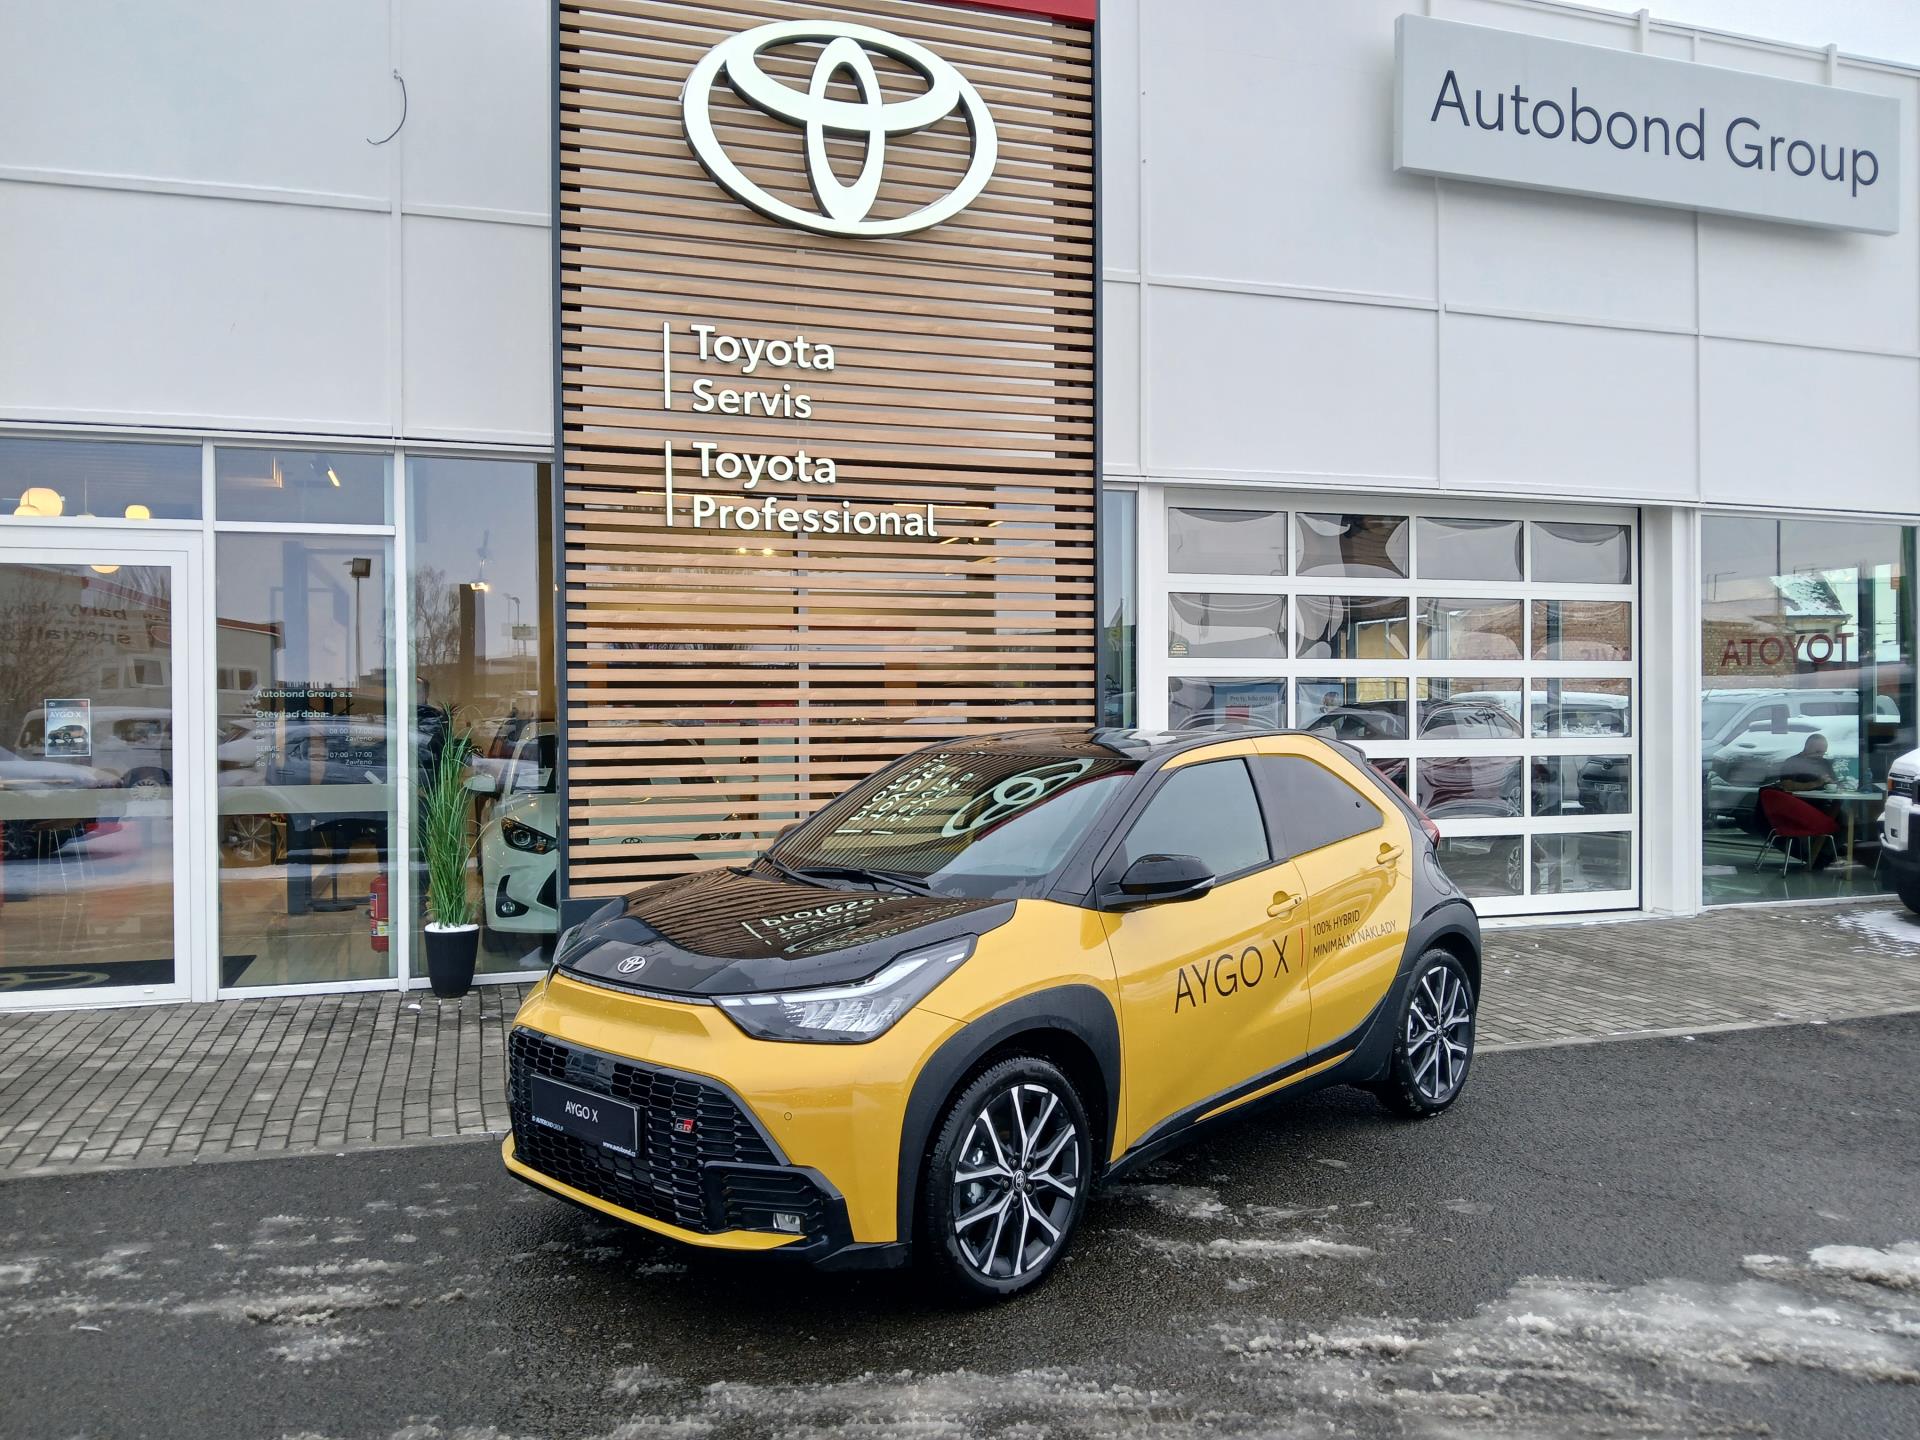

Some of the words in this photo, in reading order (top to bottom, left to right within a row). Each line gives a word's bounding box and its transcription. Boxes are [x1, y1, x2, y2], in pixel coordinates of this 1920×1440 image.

[1430, 69, 1706, 161] Autobond
[1725, 116, 1880, 198] Group
[690, 323, 835, 374] Toyota
[692, 378, 813, 419] Servis
[692, 441, 837, 490] Toyota
[693, 494, 938, 537] Professional
[255, 690, 305, 698] Autobond
[307, 690, 337, 699] Group
[1313, 920, 1333, 936] 100%
[1333, 910, 1360, 930] HYBRID
[1175, 945, 1264, 1014] AYGO
[1272, 935, 1290, 978] X
[565, 1100, 591, 1120] AYGO
[591, 1109, 599, 1123] X
